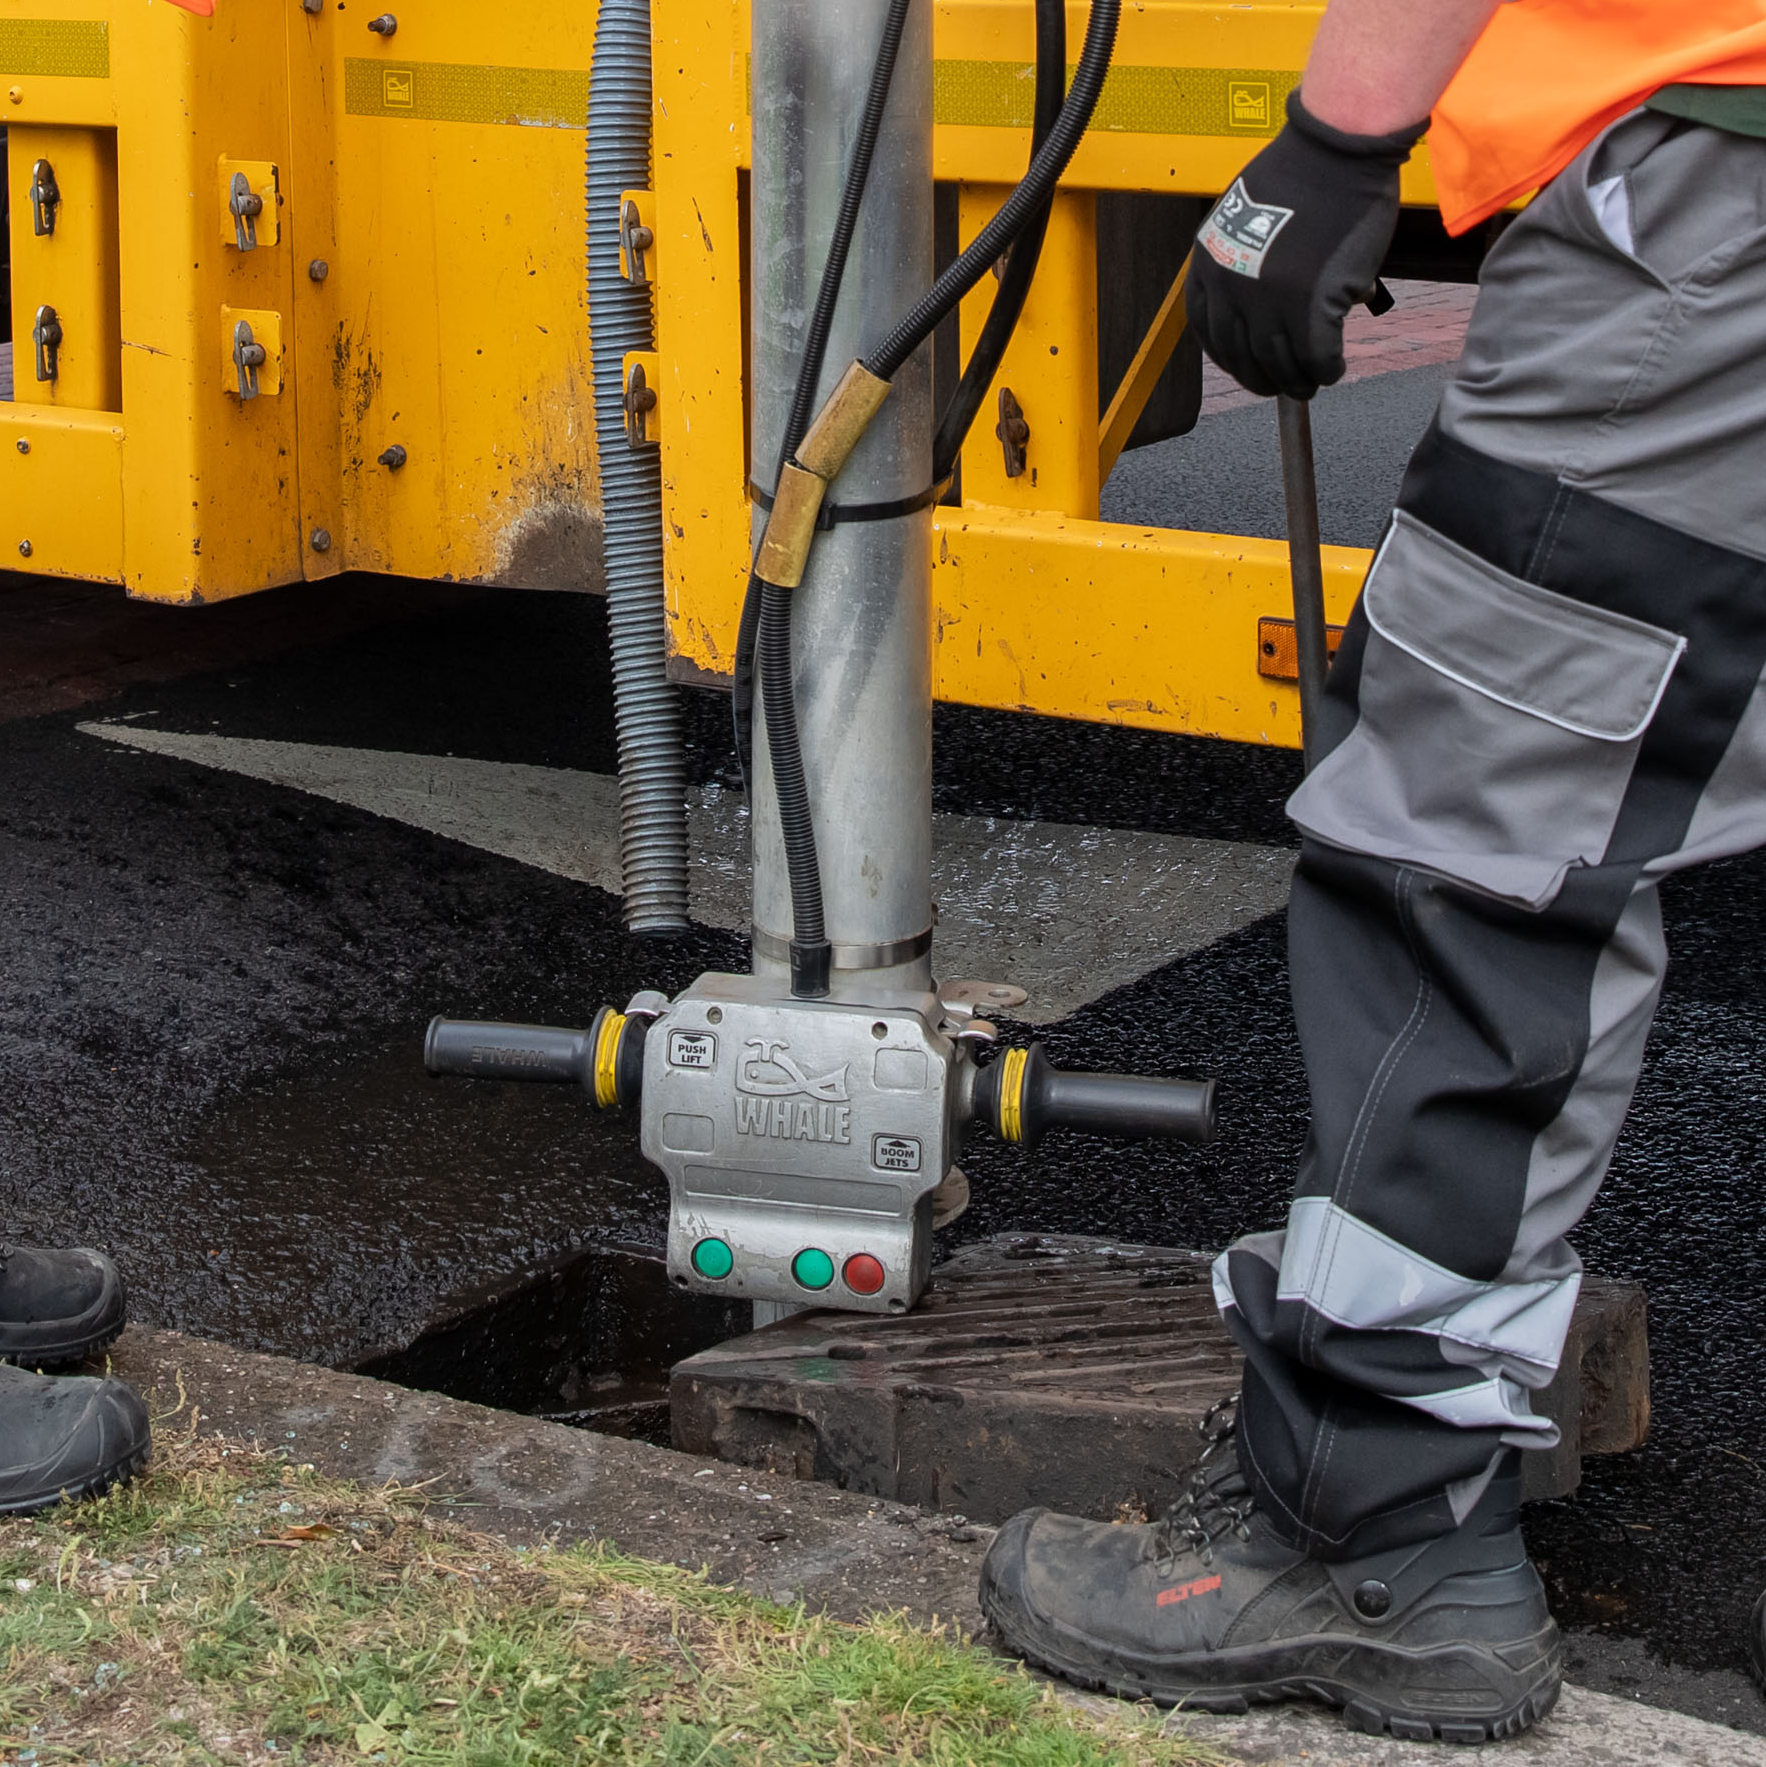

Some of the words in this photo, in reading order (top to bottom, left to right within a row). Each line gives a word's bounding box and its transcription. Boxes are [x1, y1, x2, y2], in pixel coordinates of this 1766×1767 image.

[1234, 106, 1266, 119] WHALE
[678, 1044, 707, 1054] PUSH
[471, 1046, 548, 1067] WHALE
[681, 1054, 701, 1064] LIFT
[734, 1097, 850, 1144] WHALE
[881, 1147, 915, 1159] BOOM
[884, 1158, 909, 1168] JETS
[1157, 1575, 1220, 1606] ELTEN
